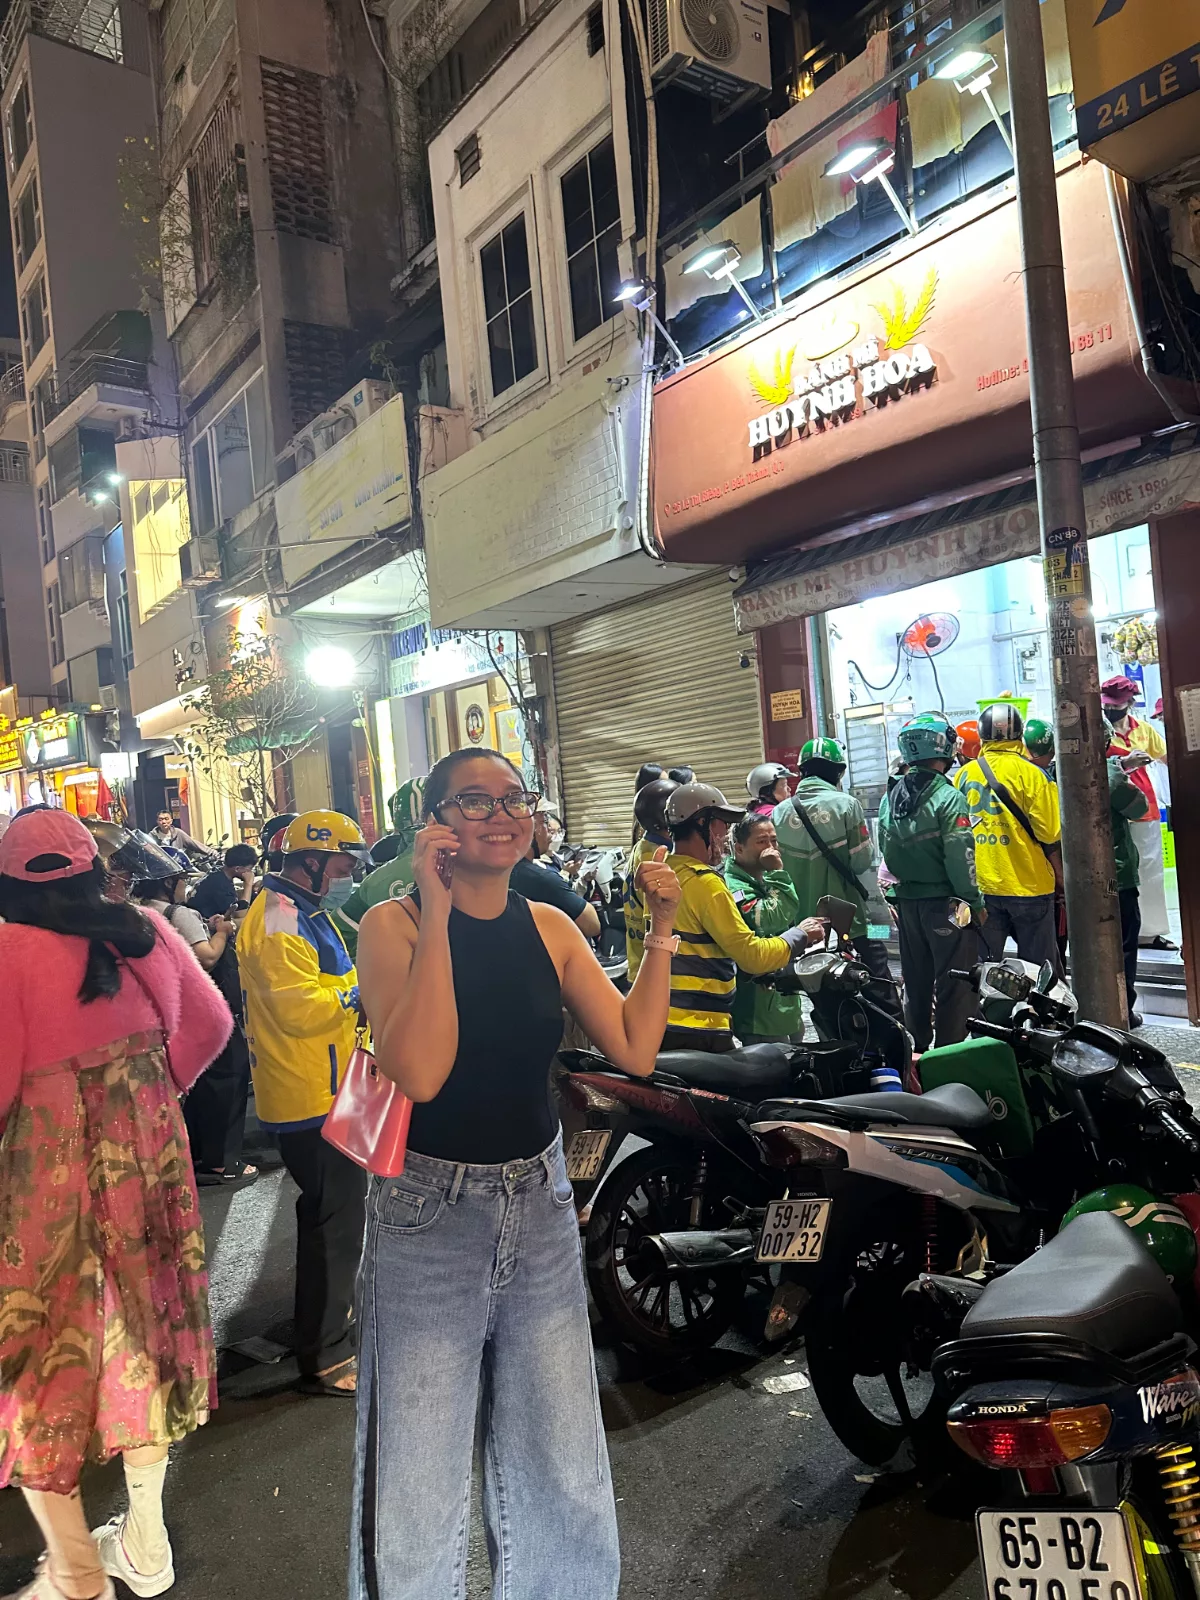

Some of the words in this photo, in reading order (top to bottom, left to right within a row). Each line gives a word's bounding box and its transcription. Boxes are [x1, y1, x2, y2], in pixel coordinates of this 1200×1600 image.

[1096, 93, 1130, 129] 24
[1139, 63, 1180, 108] LÊ
[862, 343, 937, 398] HOA
[976, 364, 1021, 391] Hotline:
[1099, 487, 1135, 510] SINCE
[1138, 478, 1169, 499] 1989
[979, 507, 1036, 542] HO
[788, 804, 831, 830] Gab
[305, 823, 333, 842] be
[572, 1133, 605, 1155] 59-L1
[887, 1145, 959, 1165] BLADE
[772, 1203, 822, 1230] 59-H2
[761, 1231, 822, 1257] 007.32
[977, 1403, 1029, 1414] HONDA
[1136, 1383, 1197, 1424] Wave
[999, 1517, 1110, 1572] 65-B2
